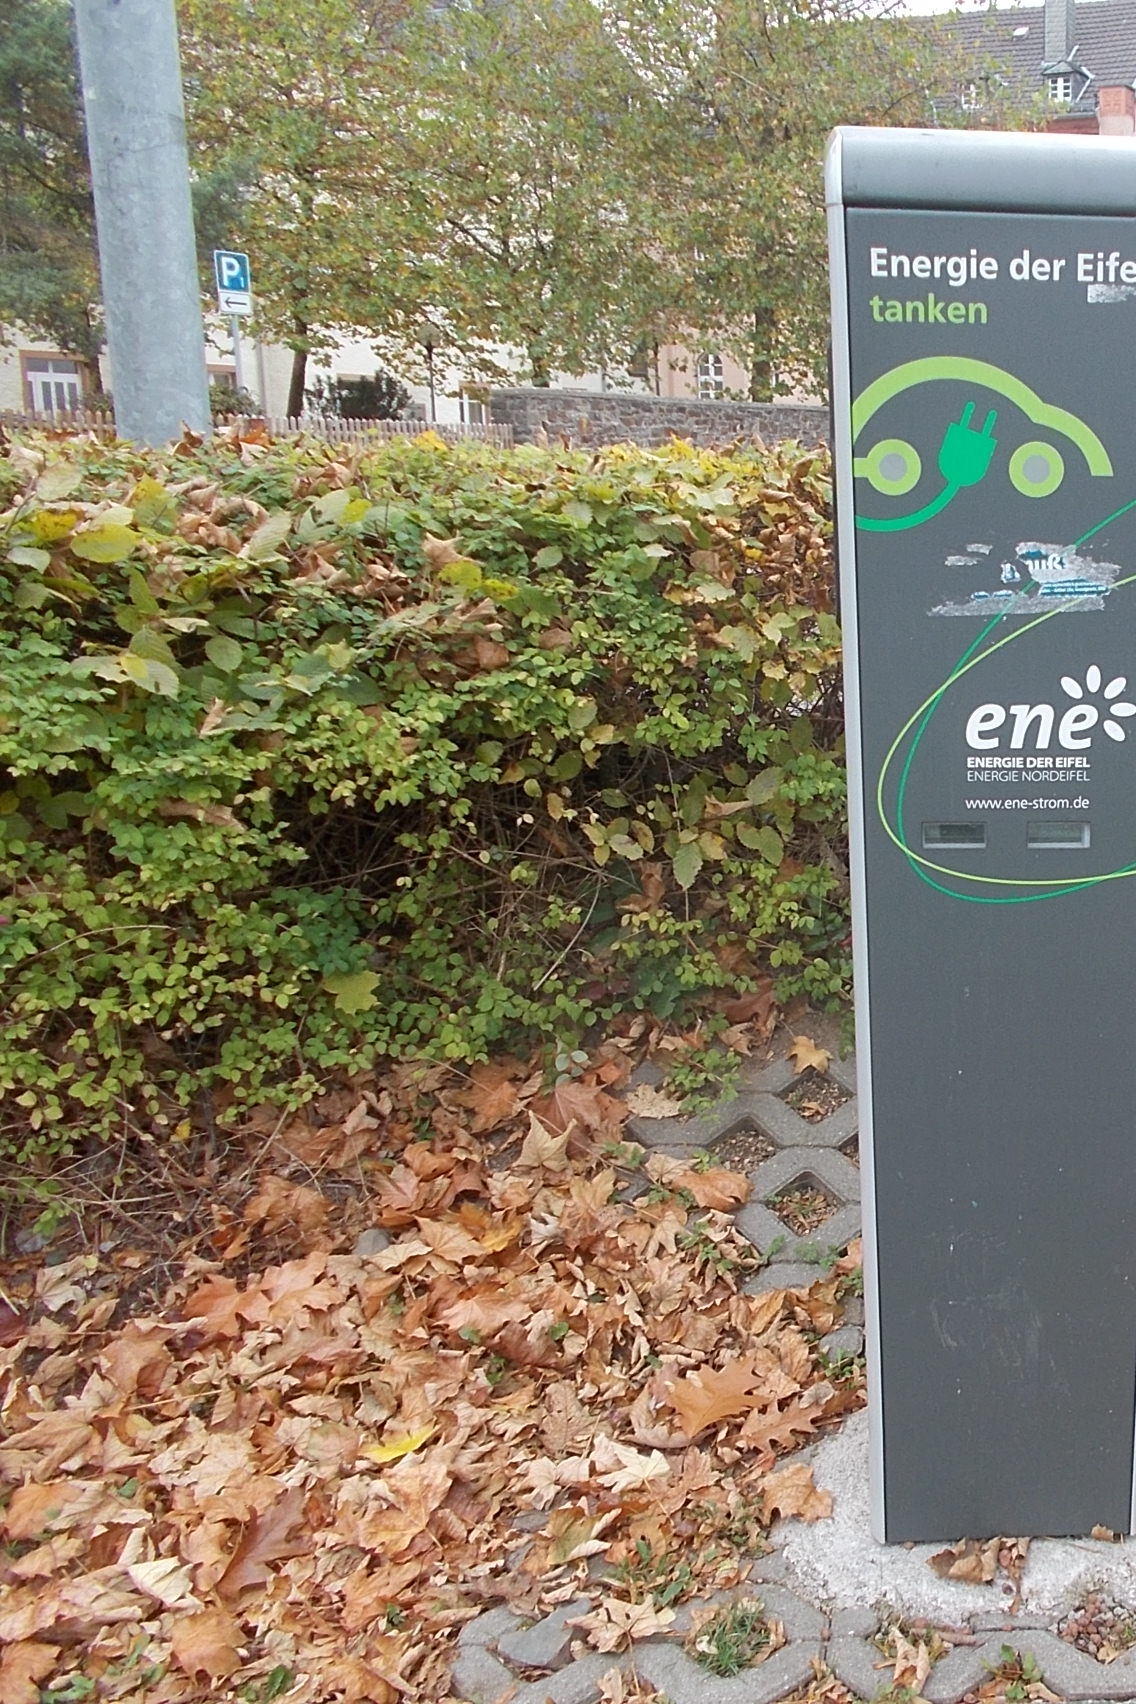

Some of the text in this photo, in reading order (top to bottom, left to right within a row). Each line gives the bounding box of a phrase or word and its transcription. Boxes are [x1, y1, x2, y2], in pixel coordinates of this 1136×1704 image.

[870, 247, 999, 287] Energie
[1009, 249, 1066, 281] der
[868, 292, 988, 325] tanken
[965, 703, 1099, 750] ene
[966, 756, 1091, 769] ENERGIE DER EIFEL
[966, 770, 1091, 782] ENERGIE NORDEIFEL
[965, 796, 1090, 810] www.ene-strom.de
